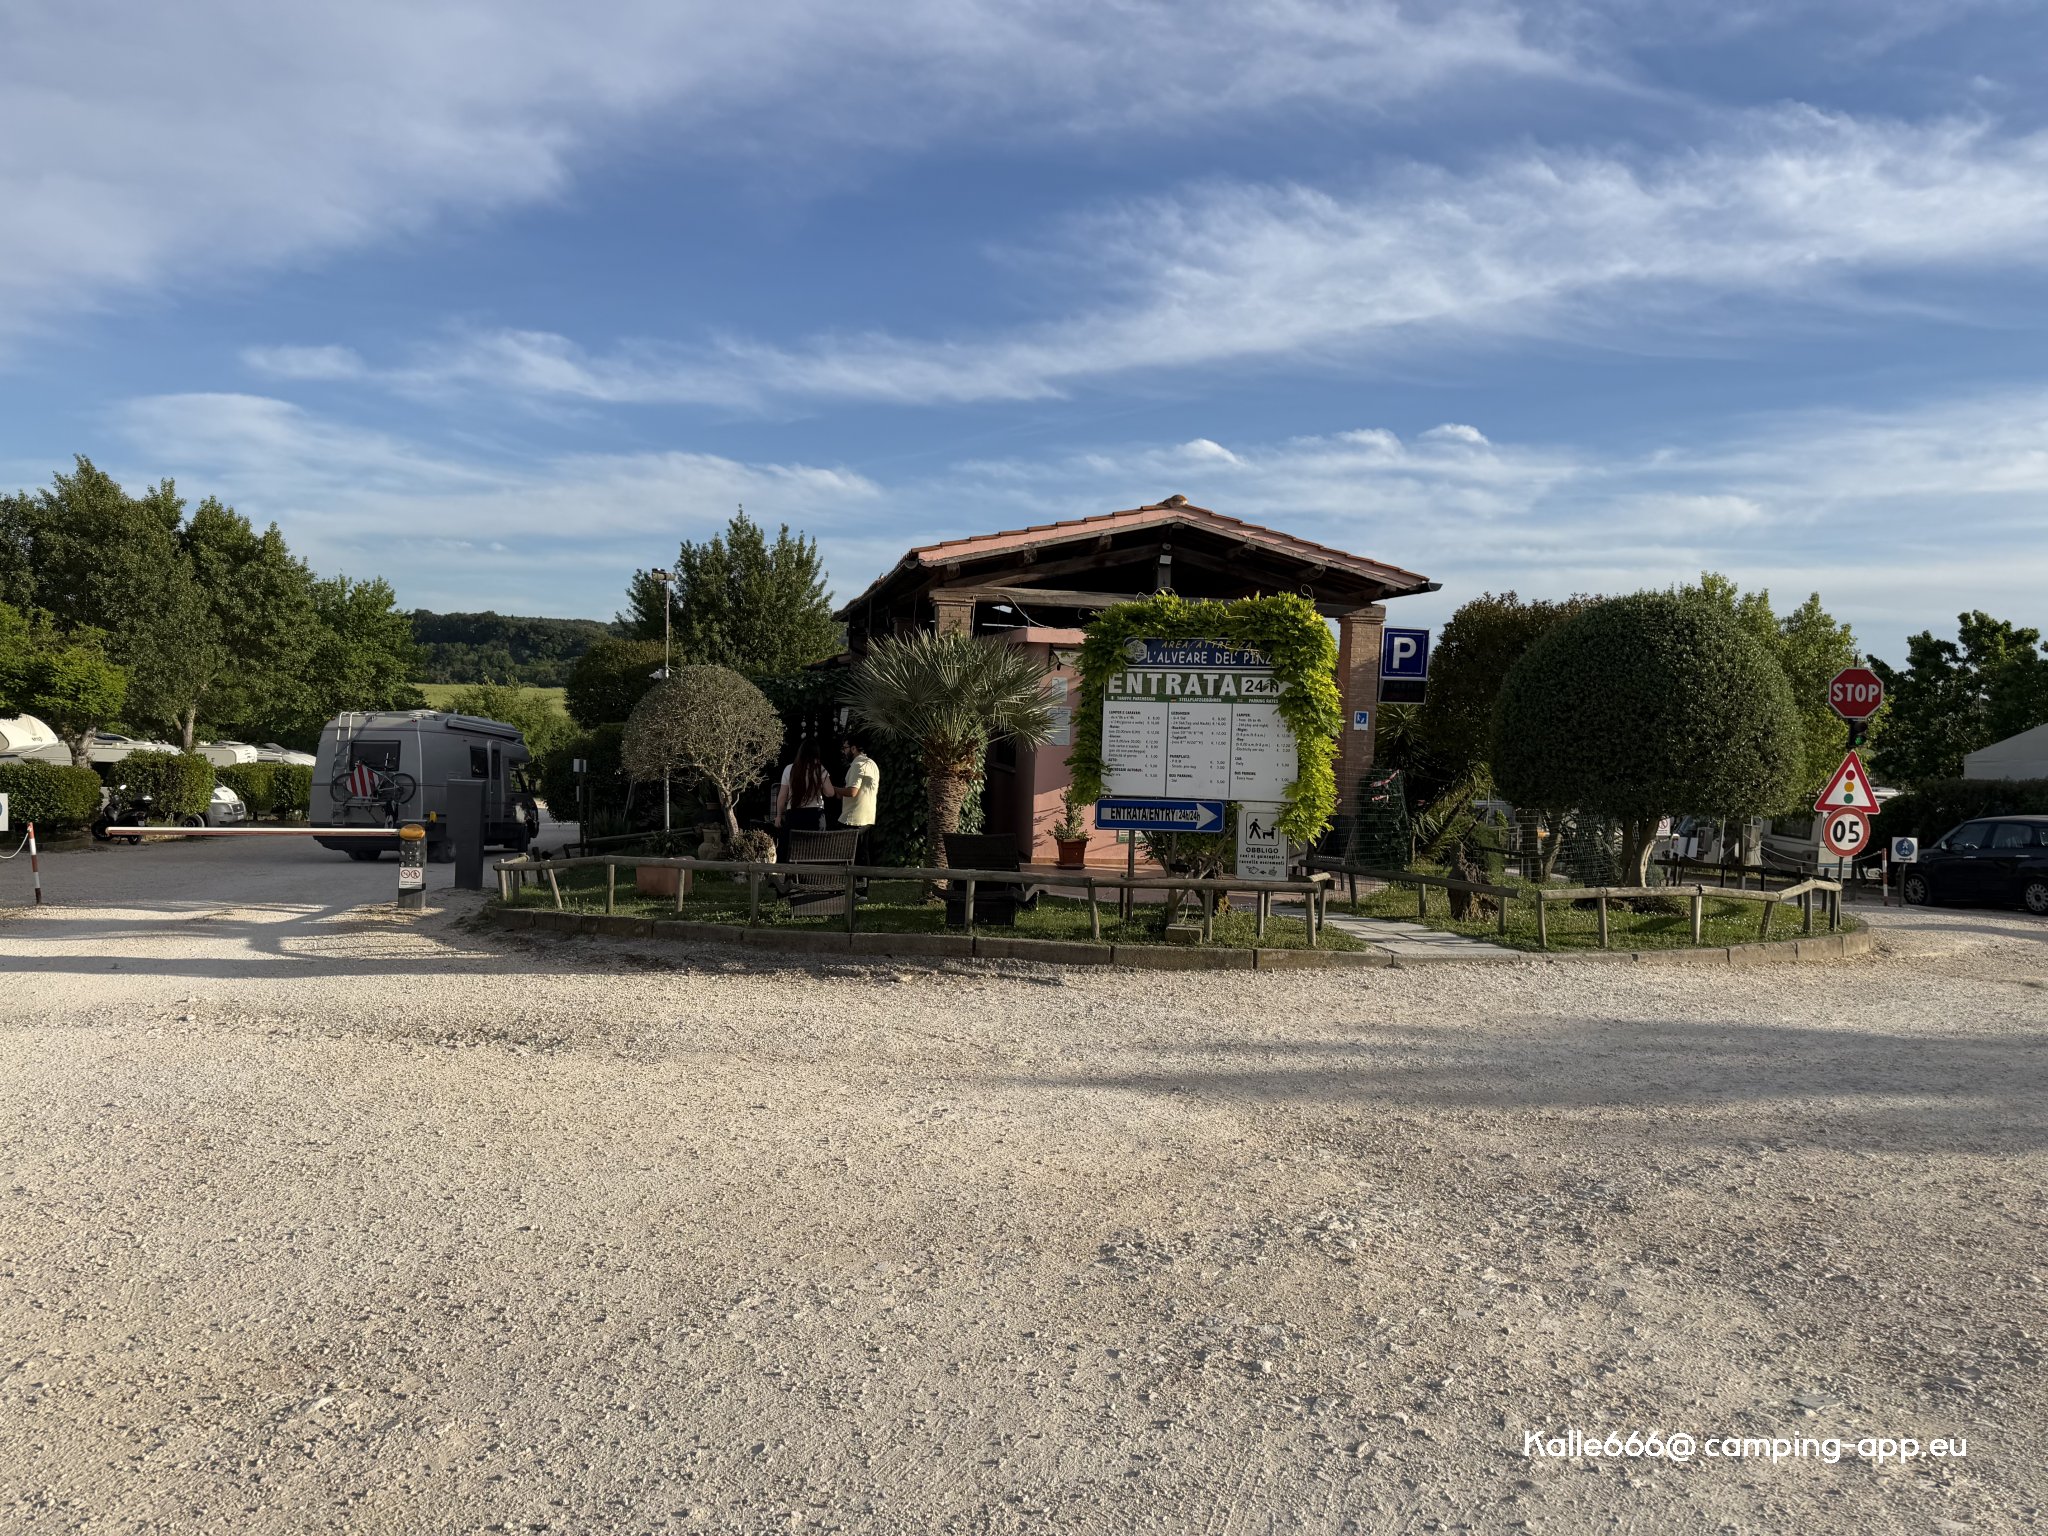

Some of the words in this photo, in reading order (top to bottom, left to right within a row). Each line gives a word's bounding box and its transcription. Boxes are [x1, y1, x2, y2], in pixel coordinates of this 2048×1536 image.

[1161, 640, 1189, 649] AREA
[1392, 637, 1416, 669] P
[1147, 651, 1208, 664] L'ALVEARE
[1108, 672, 1237, 697] ENTRATA
[1832, 682, 1880, 703] STOP
[1832, 820, 1861, 844] 05
[1245, 846, 1279, 854] OBBLIGO
